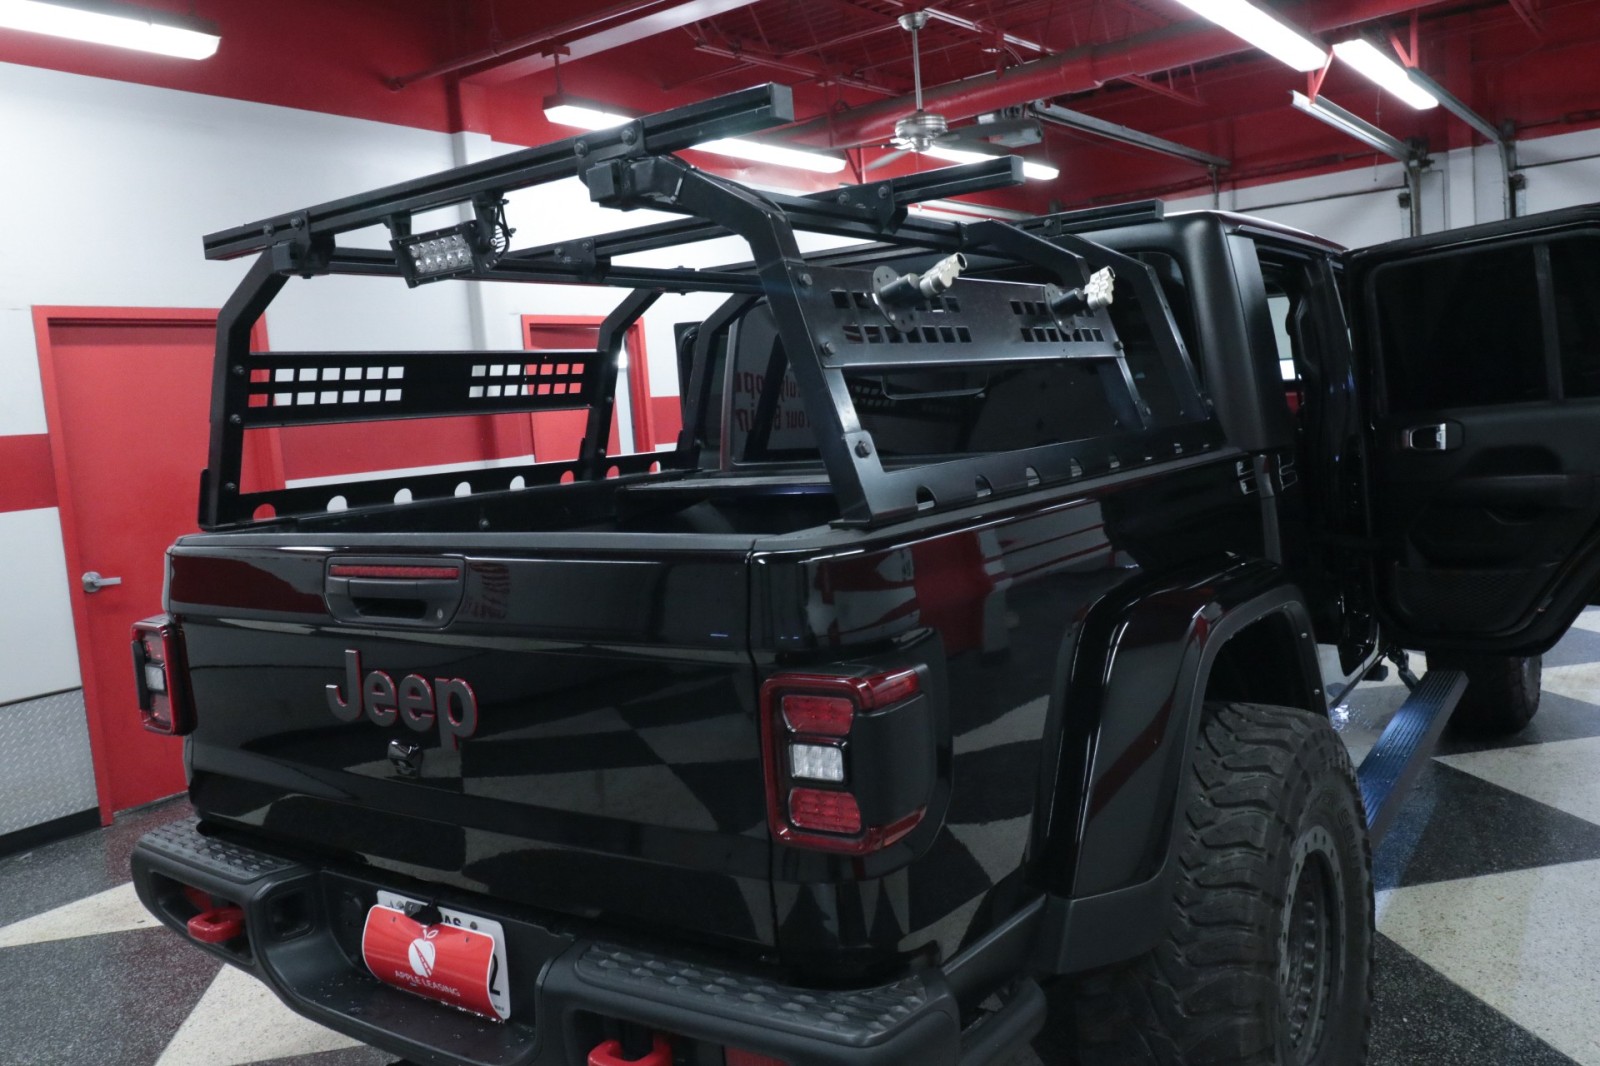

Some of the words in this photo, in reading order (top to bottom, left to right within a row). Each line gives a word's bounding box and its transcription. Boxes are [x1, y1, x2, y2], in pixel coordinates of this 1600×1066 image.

[325, 649, 478, 752] Jeep
[394, 970, 422, 985] APPLE
[421, 977, 461, 997] LEASING
